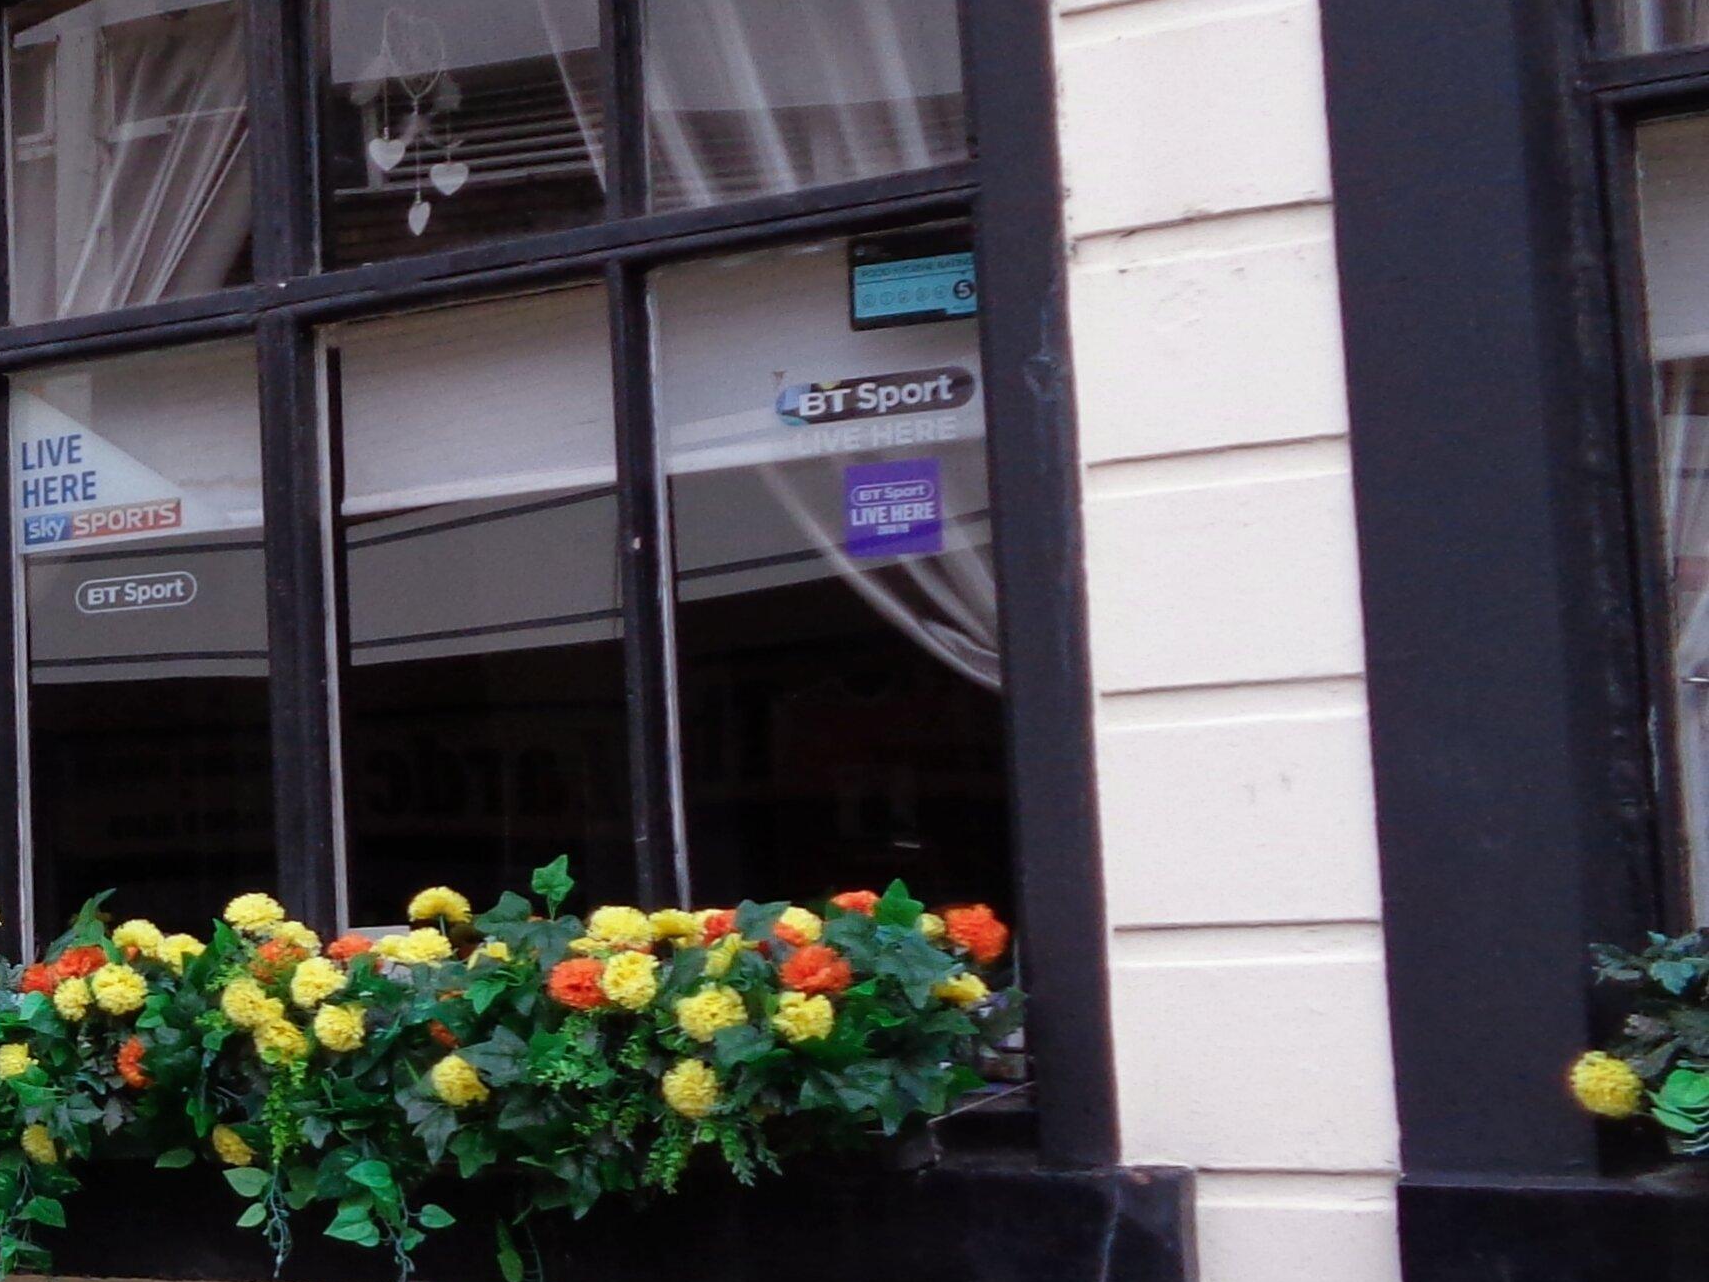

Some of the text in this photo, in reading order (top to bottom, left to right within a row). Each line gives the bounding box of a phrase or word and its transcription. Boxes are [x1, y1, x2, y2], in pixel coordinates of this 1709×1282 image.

[799, 374, 954, 417] BT Sport
[22, 434, 83, 470] LIVE
[23, 471, 97, 508] HERE
[884, 485, 925, 500] Sport
[28, 502, 178, 544] sky SPORTS
[852, 501, 936, 526] LIVE HERE
[87, 579, 185, 606] BT Sport
